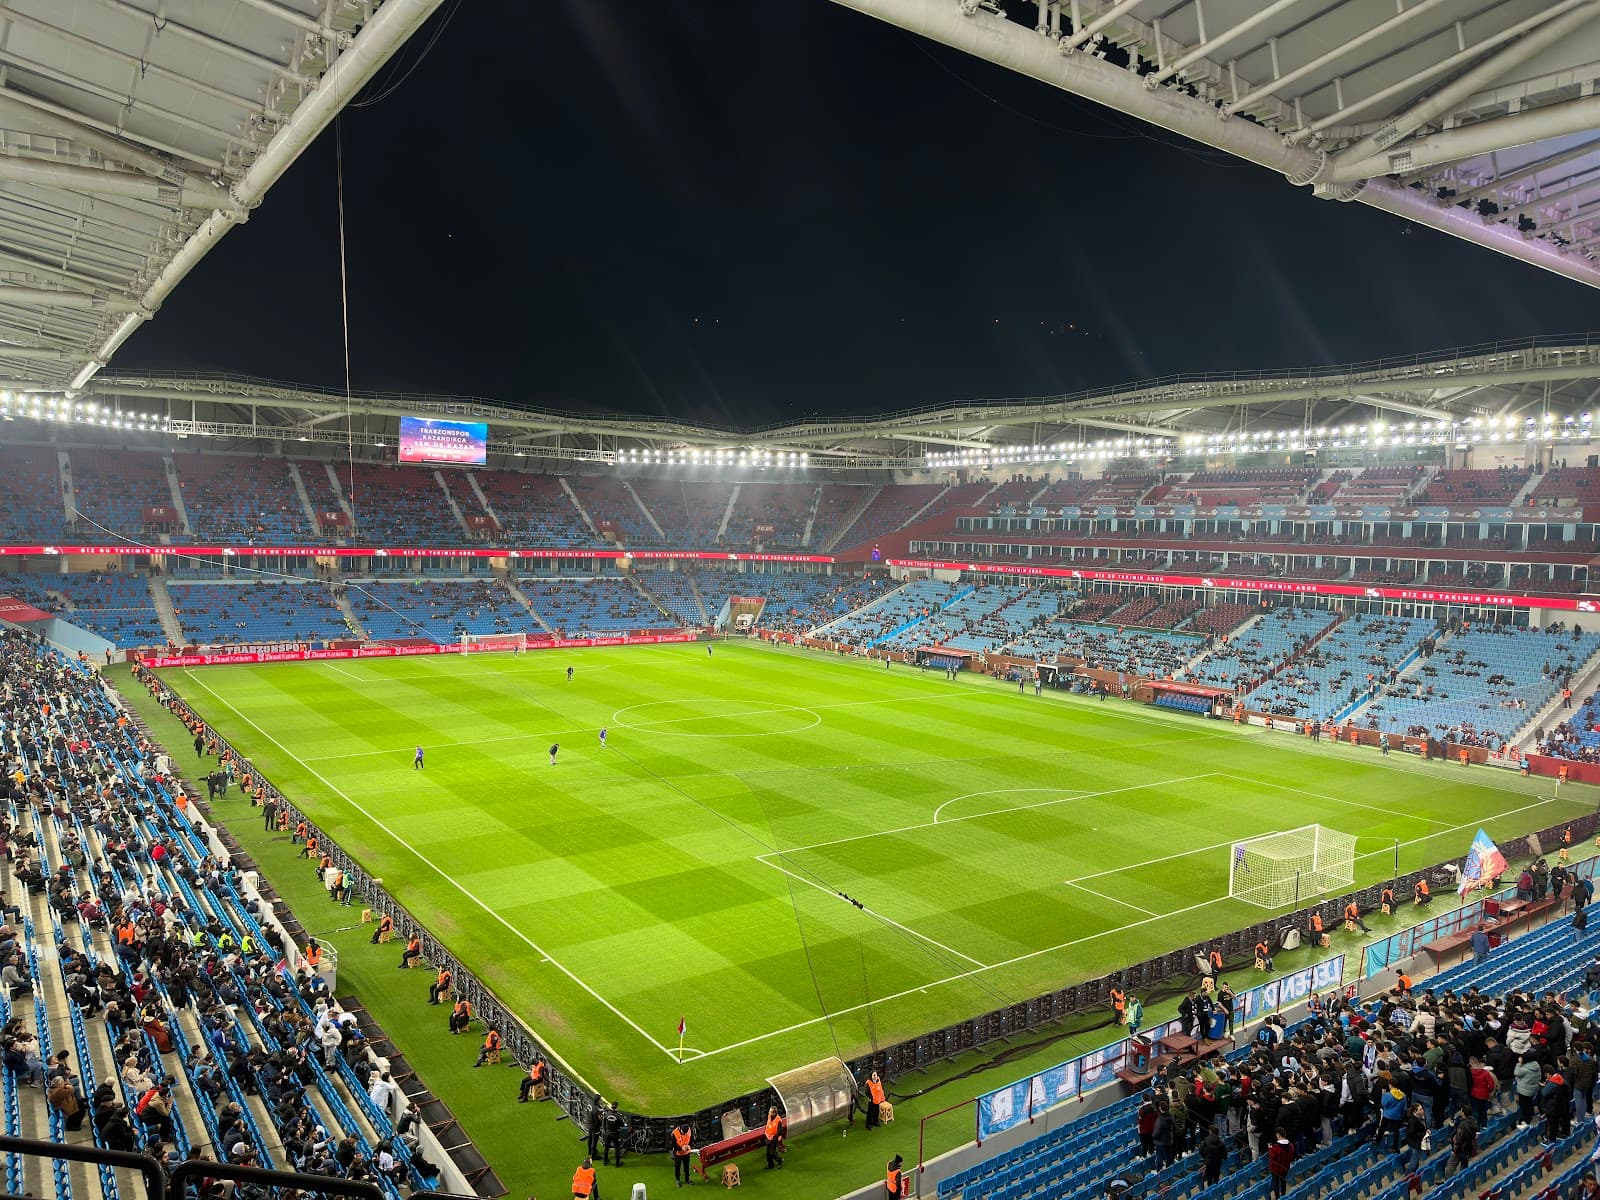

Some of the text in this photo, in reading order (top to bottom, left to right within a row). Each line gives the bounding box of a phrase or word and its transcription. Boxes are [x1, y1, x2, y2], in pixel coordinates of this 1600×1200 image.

[420, 427, 470, 437] TRABZONSPOR
[1260, 582, 1292, 590] TAKIMIN
[1439, 593, 1480, 601] TAKIMIN
[1260, 1030, 1270, 1041] 61
